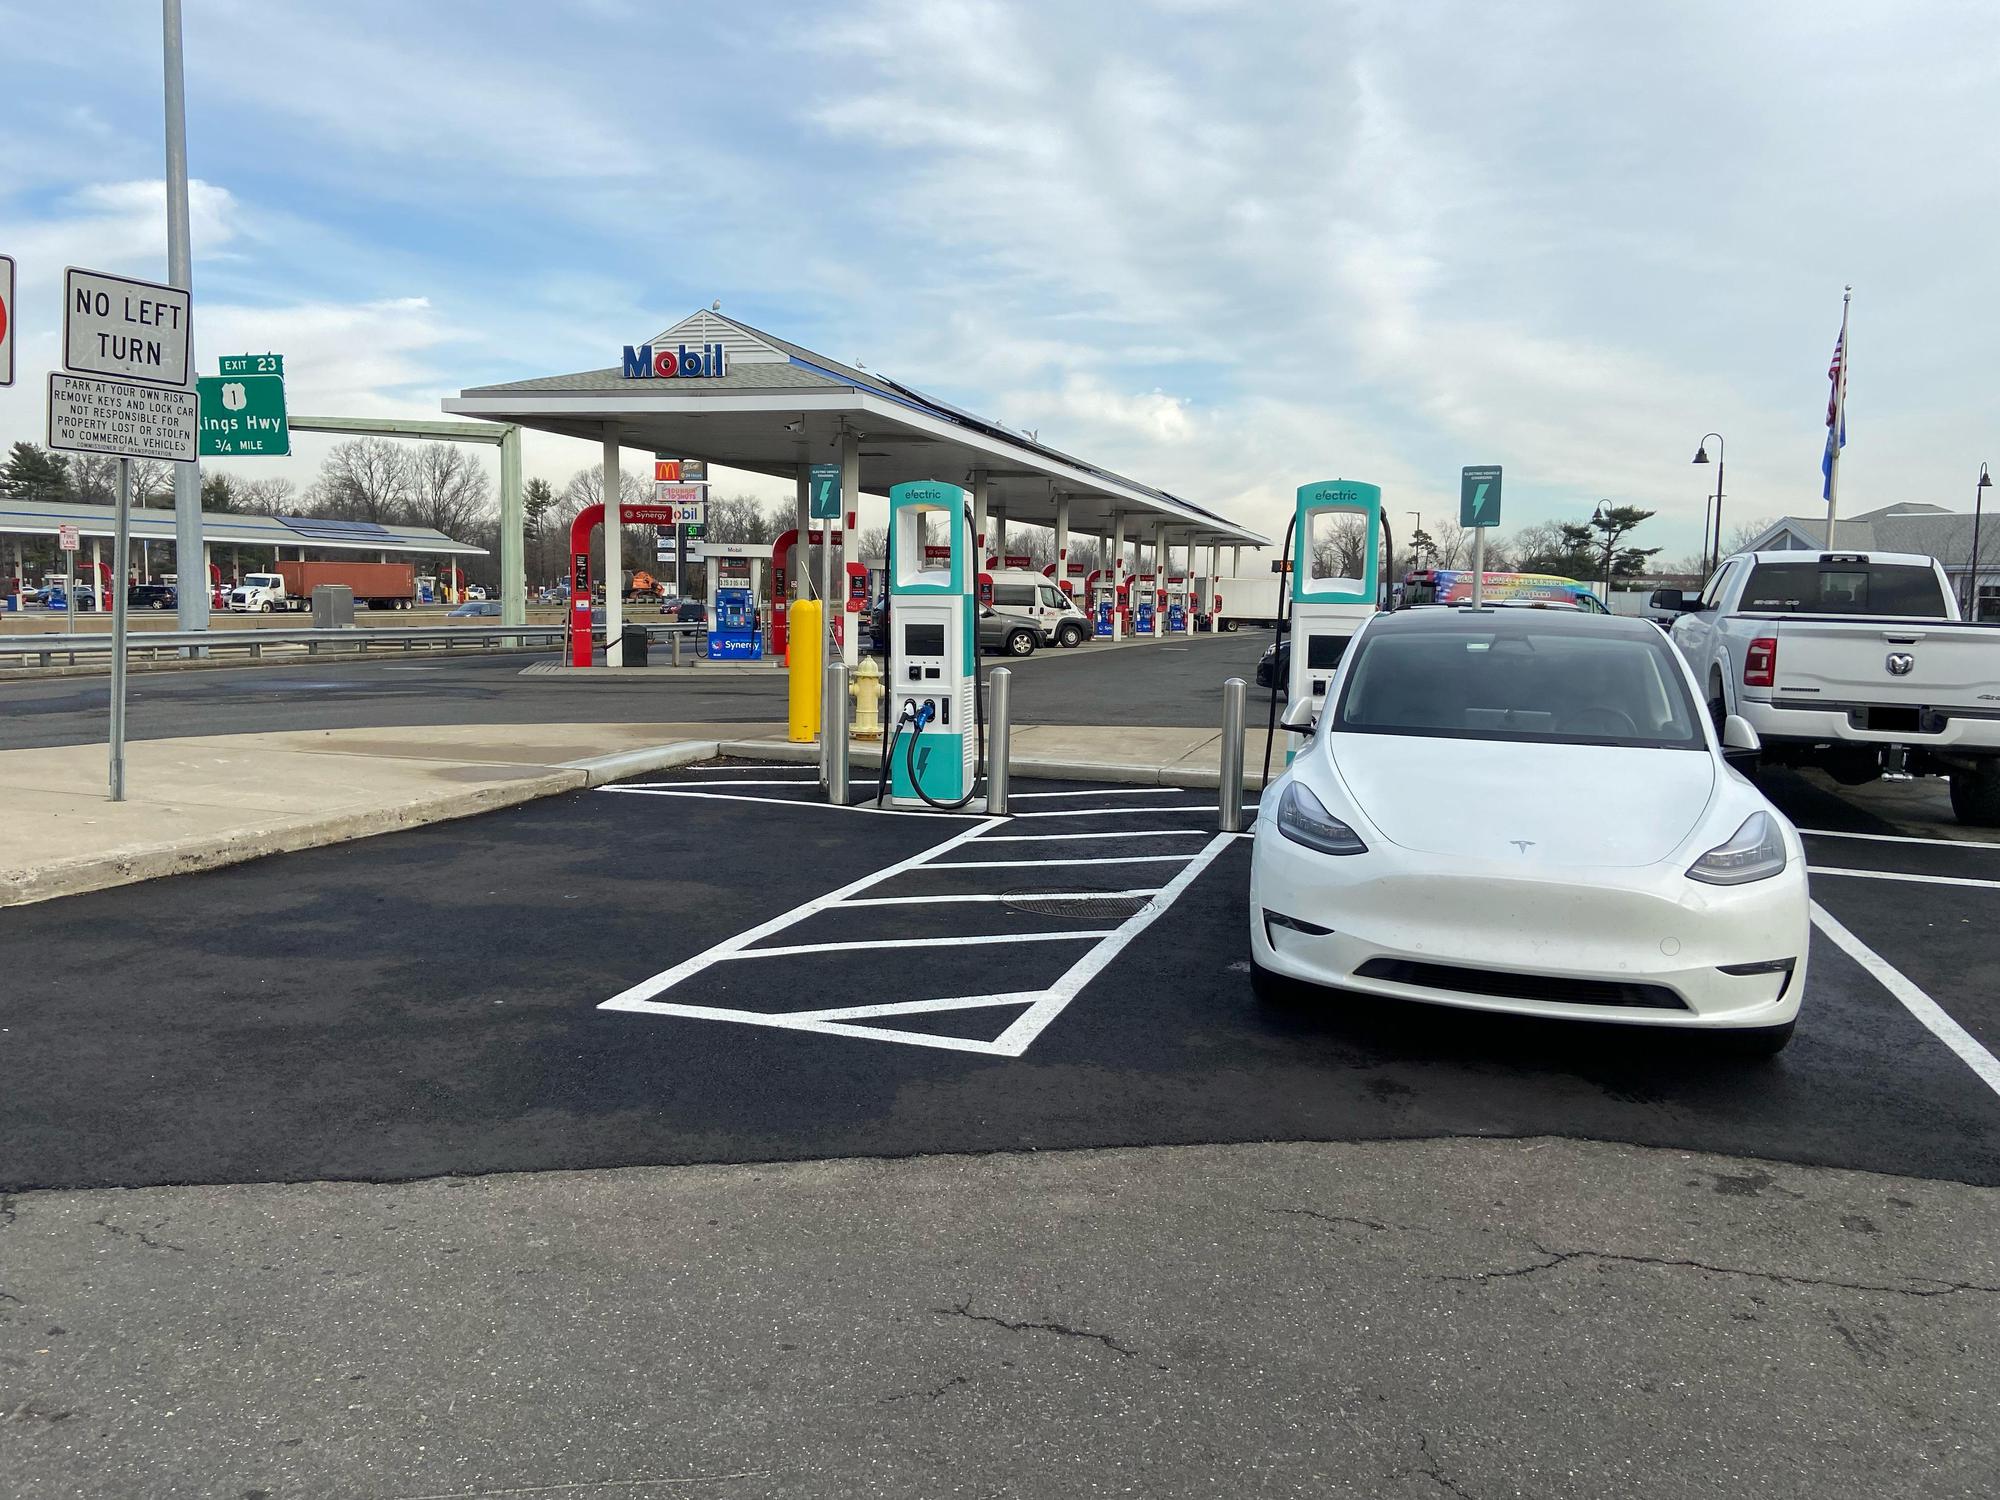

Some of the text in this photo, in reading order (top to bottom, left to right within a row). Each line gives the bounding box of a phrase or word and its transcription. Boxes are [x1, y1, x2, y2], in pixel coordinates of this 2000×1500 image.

[77, 288, 181, 330] NO LEFT
[97, 333, 160, 366] TURN
[225, 358, 277, 371] EXIT 23
[623, 344, 724, 377] Mobil
[65, 379, 184, 404] PARK AT YOUR OWN RISK
[231, 390, 237, 406] 1
[54, 390, 194, 417] REMOVE KEYS AND LOCK CAR
[57, 415, 107, 430] PROPERTY
[112, 421, 134, 433] LOST
[140, 425, 151, 435] OR
[70, 404, 179, 427] NOT RESPONSIBLE FOR
[200, 415, 280, 435] ings Hwy
[61, 429, 186, 451] NO COMMERCIAL VEHICLES
[240, 441, 263, 450] MILE
[128, 447, 172, 457] TRANSPORTATION
[905, 489, 942, 499] electric
[1315, 489, 1358, 501] electric
[636, 511, 667, 520] Synergy
[673, 507, 697, 520] obil
